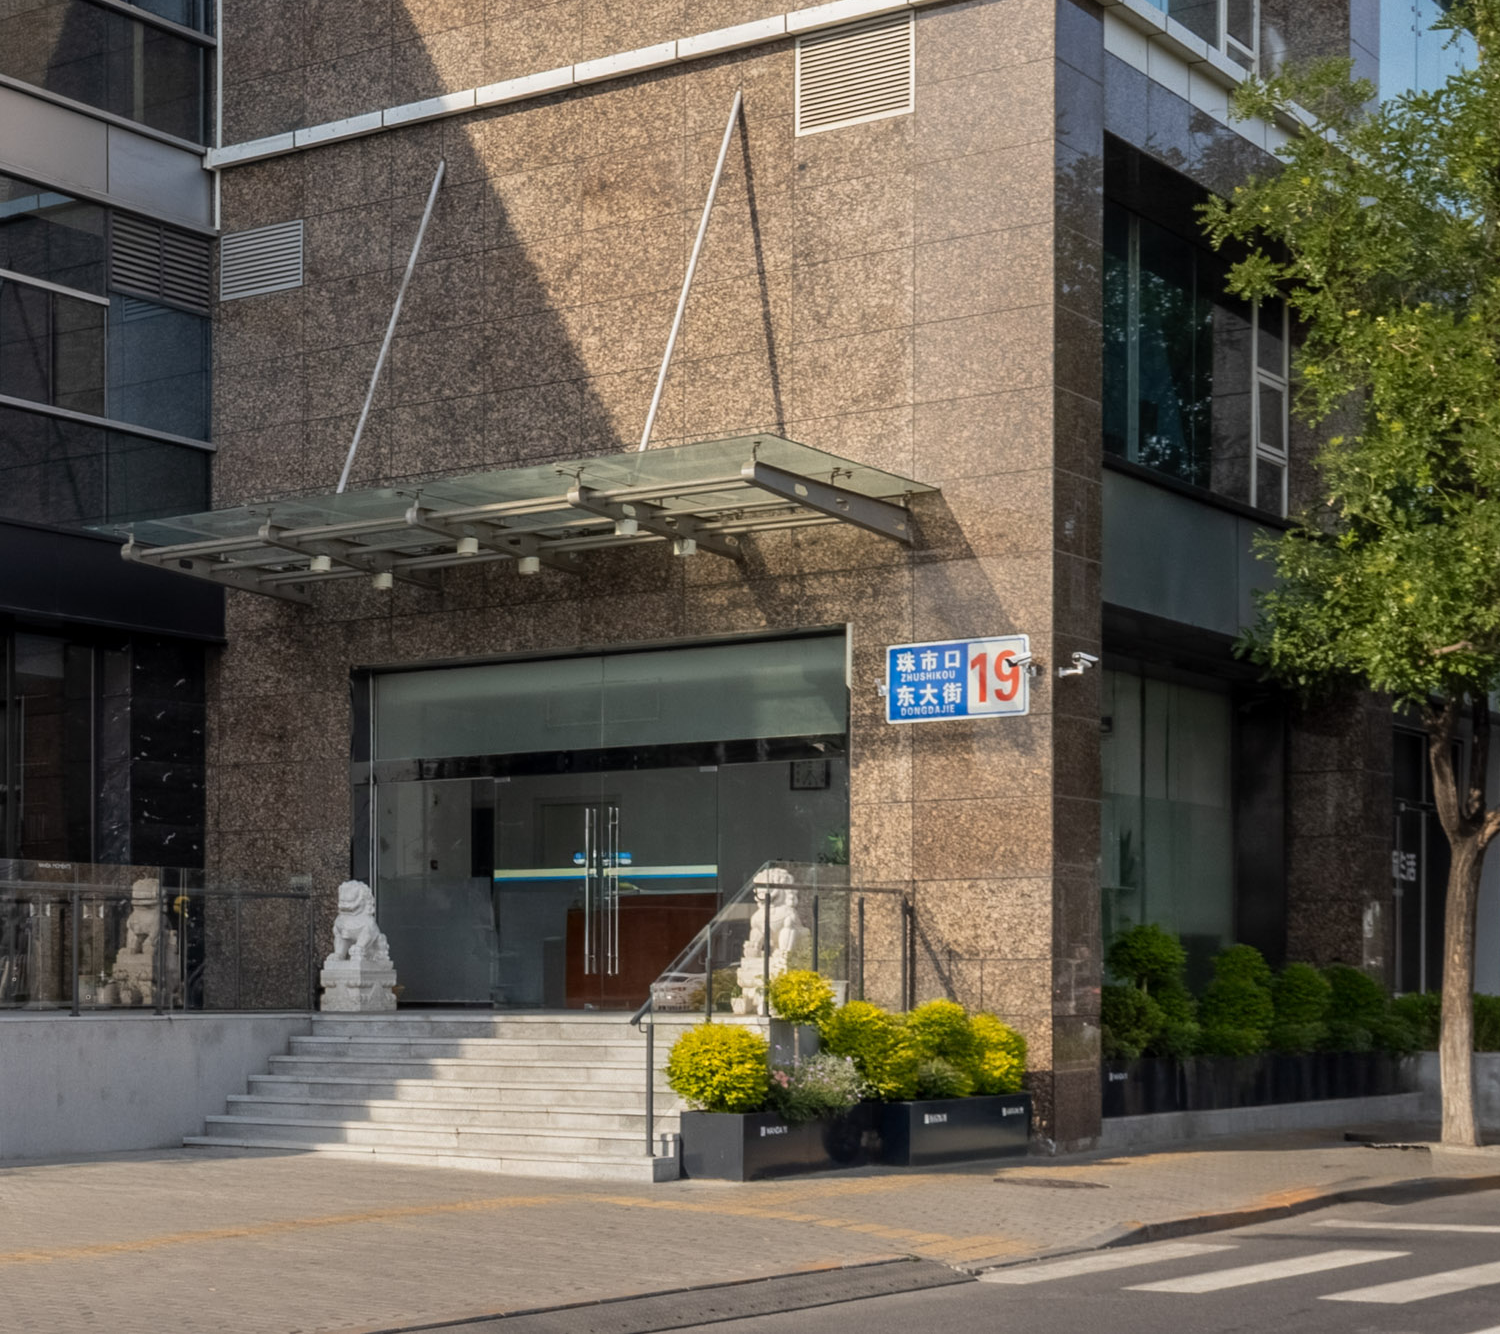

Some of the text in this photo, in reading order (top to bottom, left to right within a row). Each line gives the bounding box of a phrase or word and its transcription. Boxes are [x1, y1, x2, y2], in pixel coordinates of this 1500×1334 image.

[896, 650, 961, 673] 珠市口
[901, 670, 956, 683] ZHUSHIKOU
[970, 649, 1020, 703] 19
[896, 682, 962, 707] 东大街
[900, 704, 956, 716] DONGDAJIE
